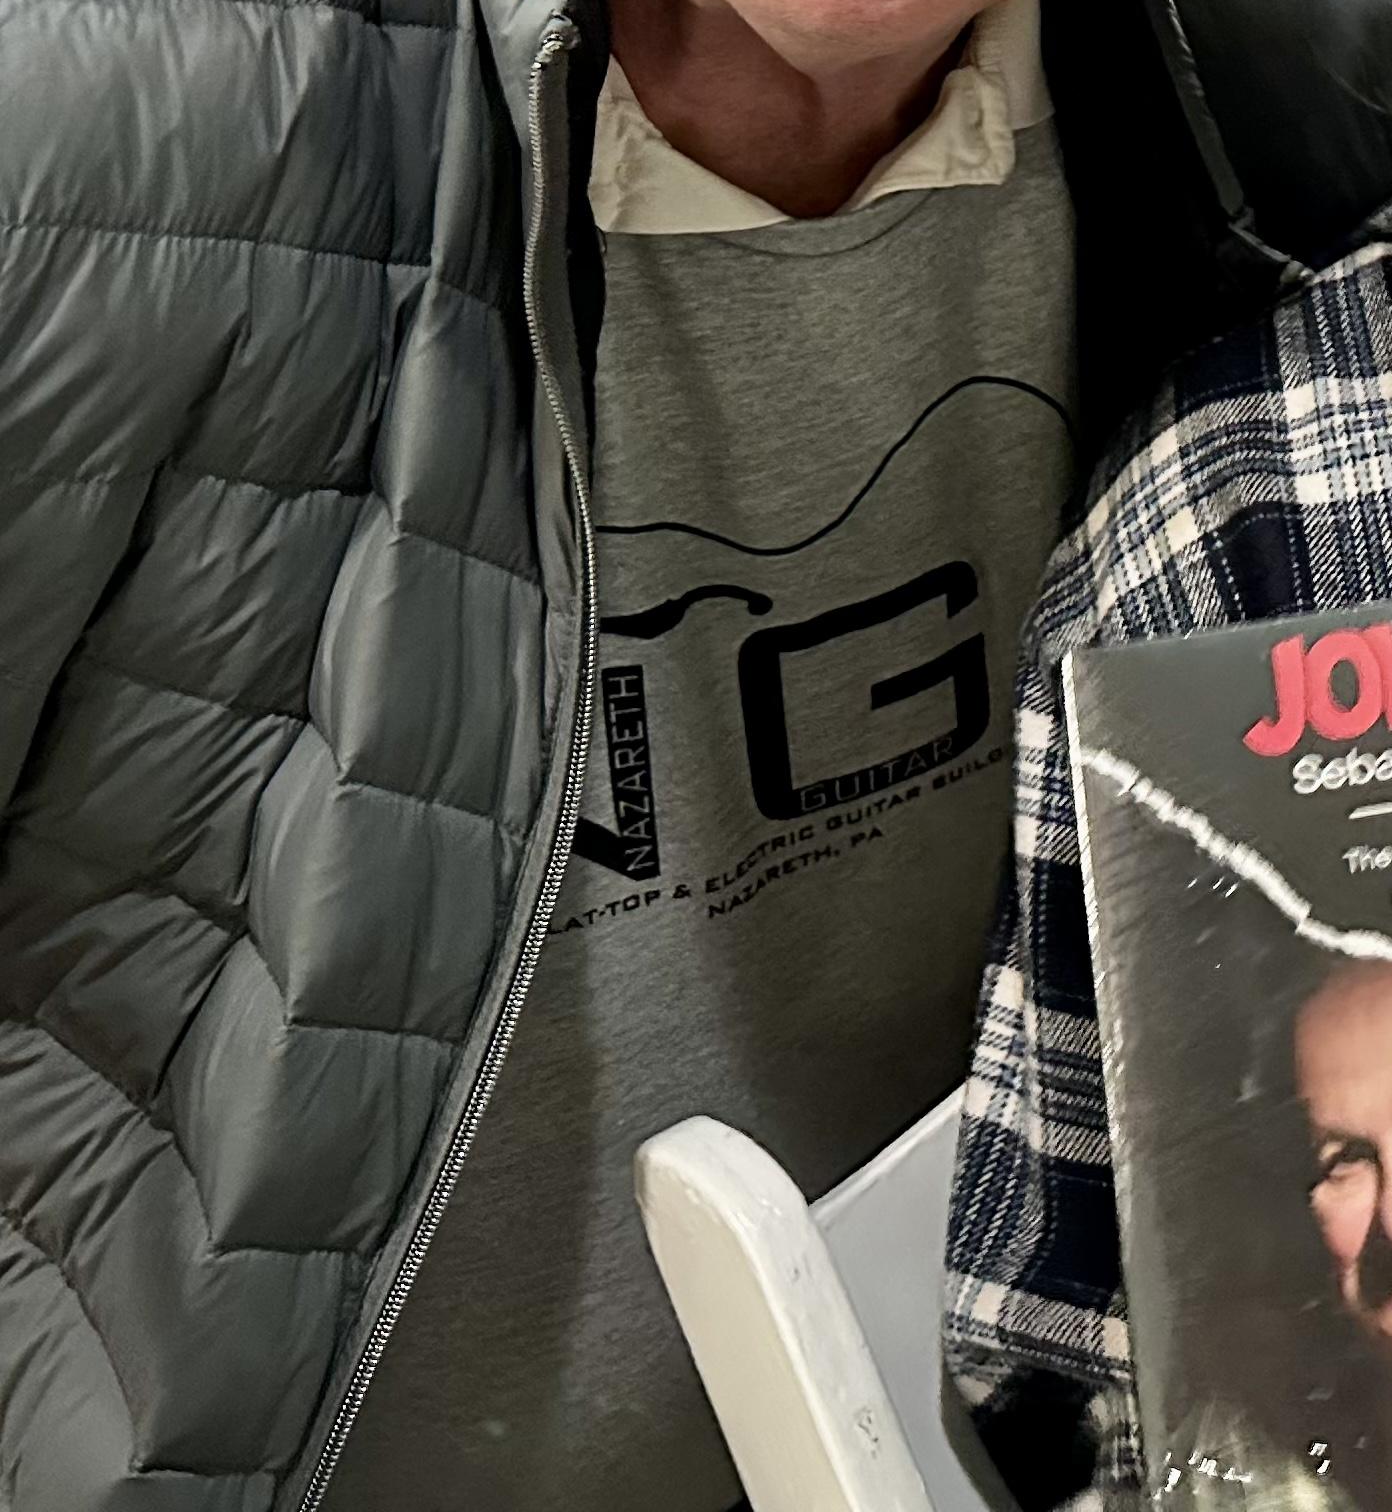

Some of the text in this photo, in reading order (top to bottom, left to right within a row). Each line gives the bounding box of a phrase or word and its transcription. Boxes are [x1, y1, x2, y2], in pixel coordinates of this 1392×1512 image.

[606, 674, 657, 872] NAZARETH
[800, 737, 954, 813] GUITAR
[548, 888, 661, 936] LAT-TOP
[671, 883, 693, 899] &
[704, 824, 815, 894] ELECTRIC
[825, 785, 921, 831] GUITAR
[850, 826, 883, 849] PA
